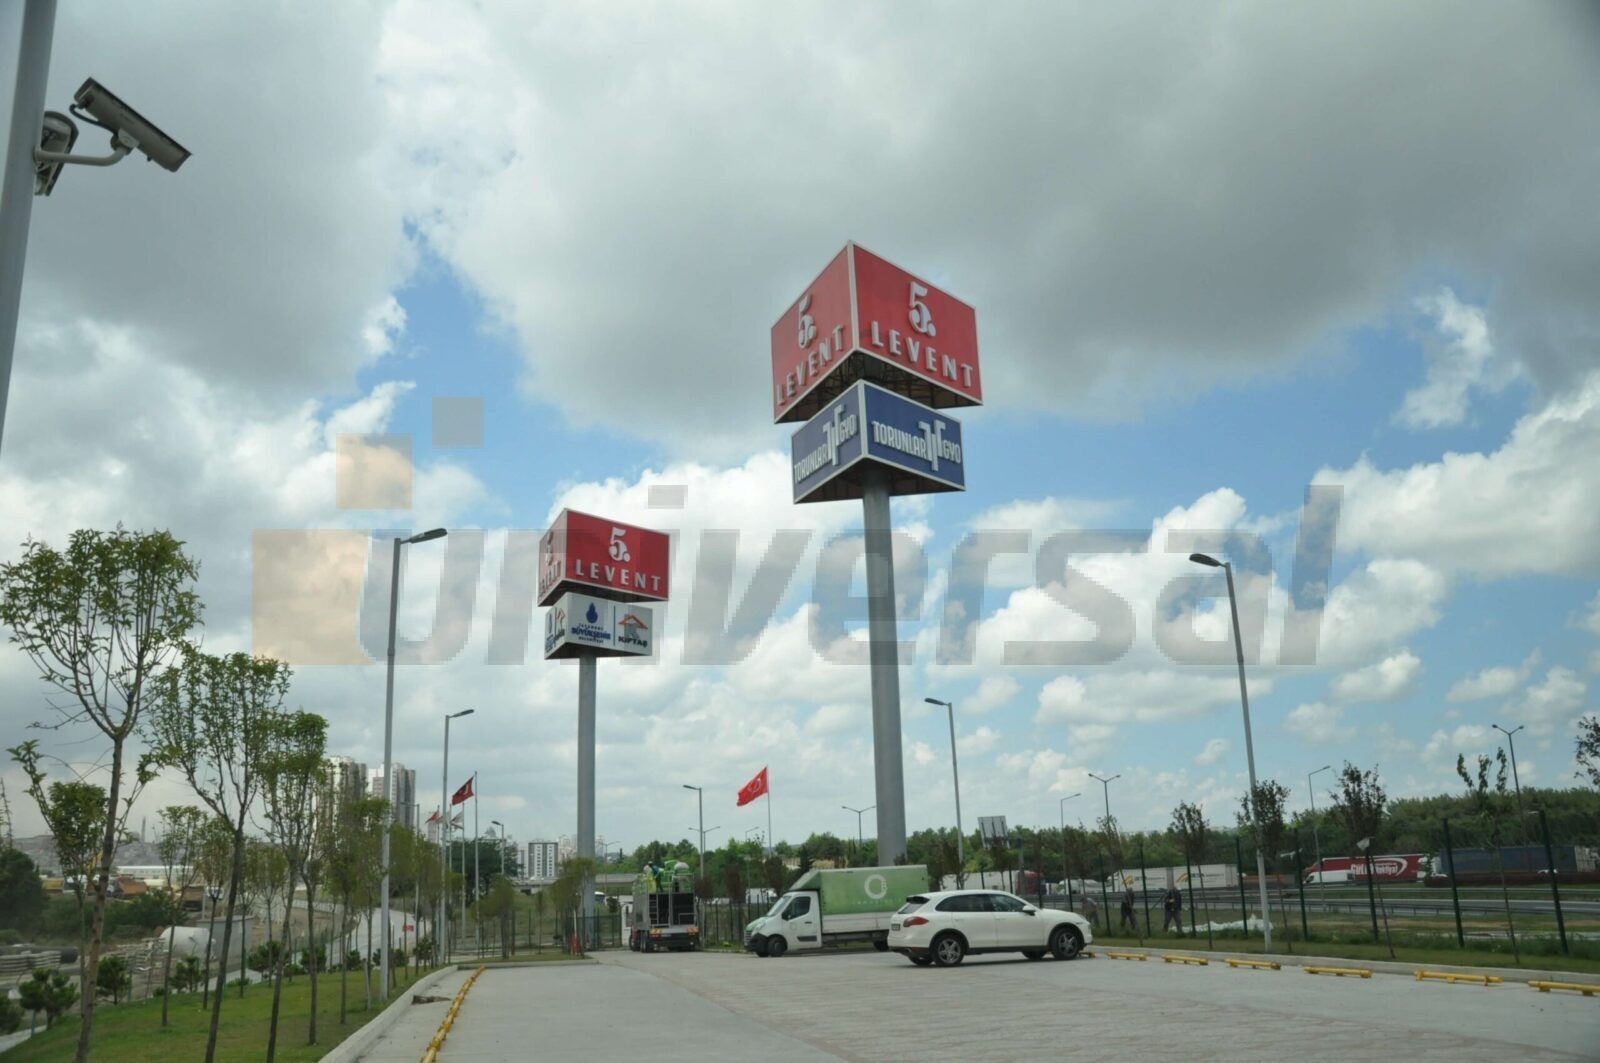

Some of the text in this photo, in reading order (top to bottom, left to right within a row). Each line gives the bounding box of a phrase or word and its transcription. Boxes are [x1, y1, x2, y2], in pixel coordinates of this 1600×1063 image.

[775, 324, 845, 406] LEVENT
[870, 320, 973, 388] LEVENT
[794, 414, 857, 484] TORUNLAR GYO
[872, 420, 961, 464] TORUNLAR GYO
[575, 559, 661, 591] LEVENT
